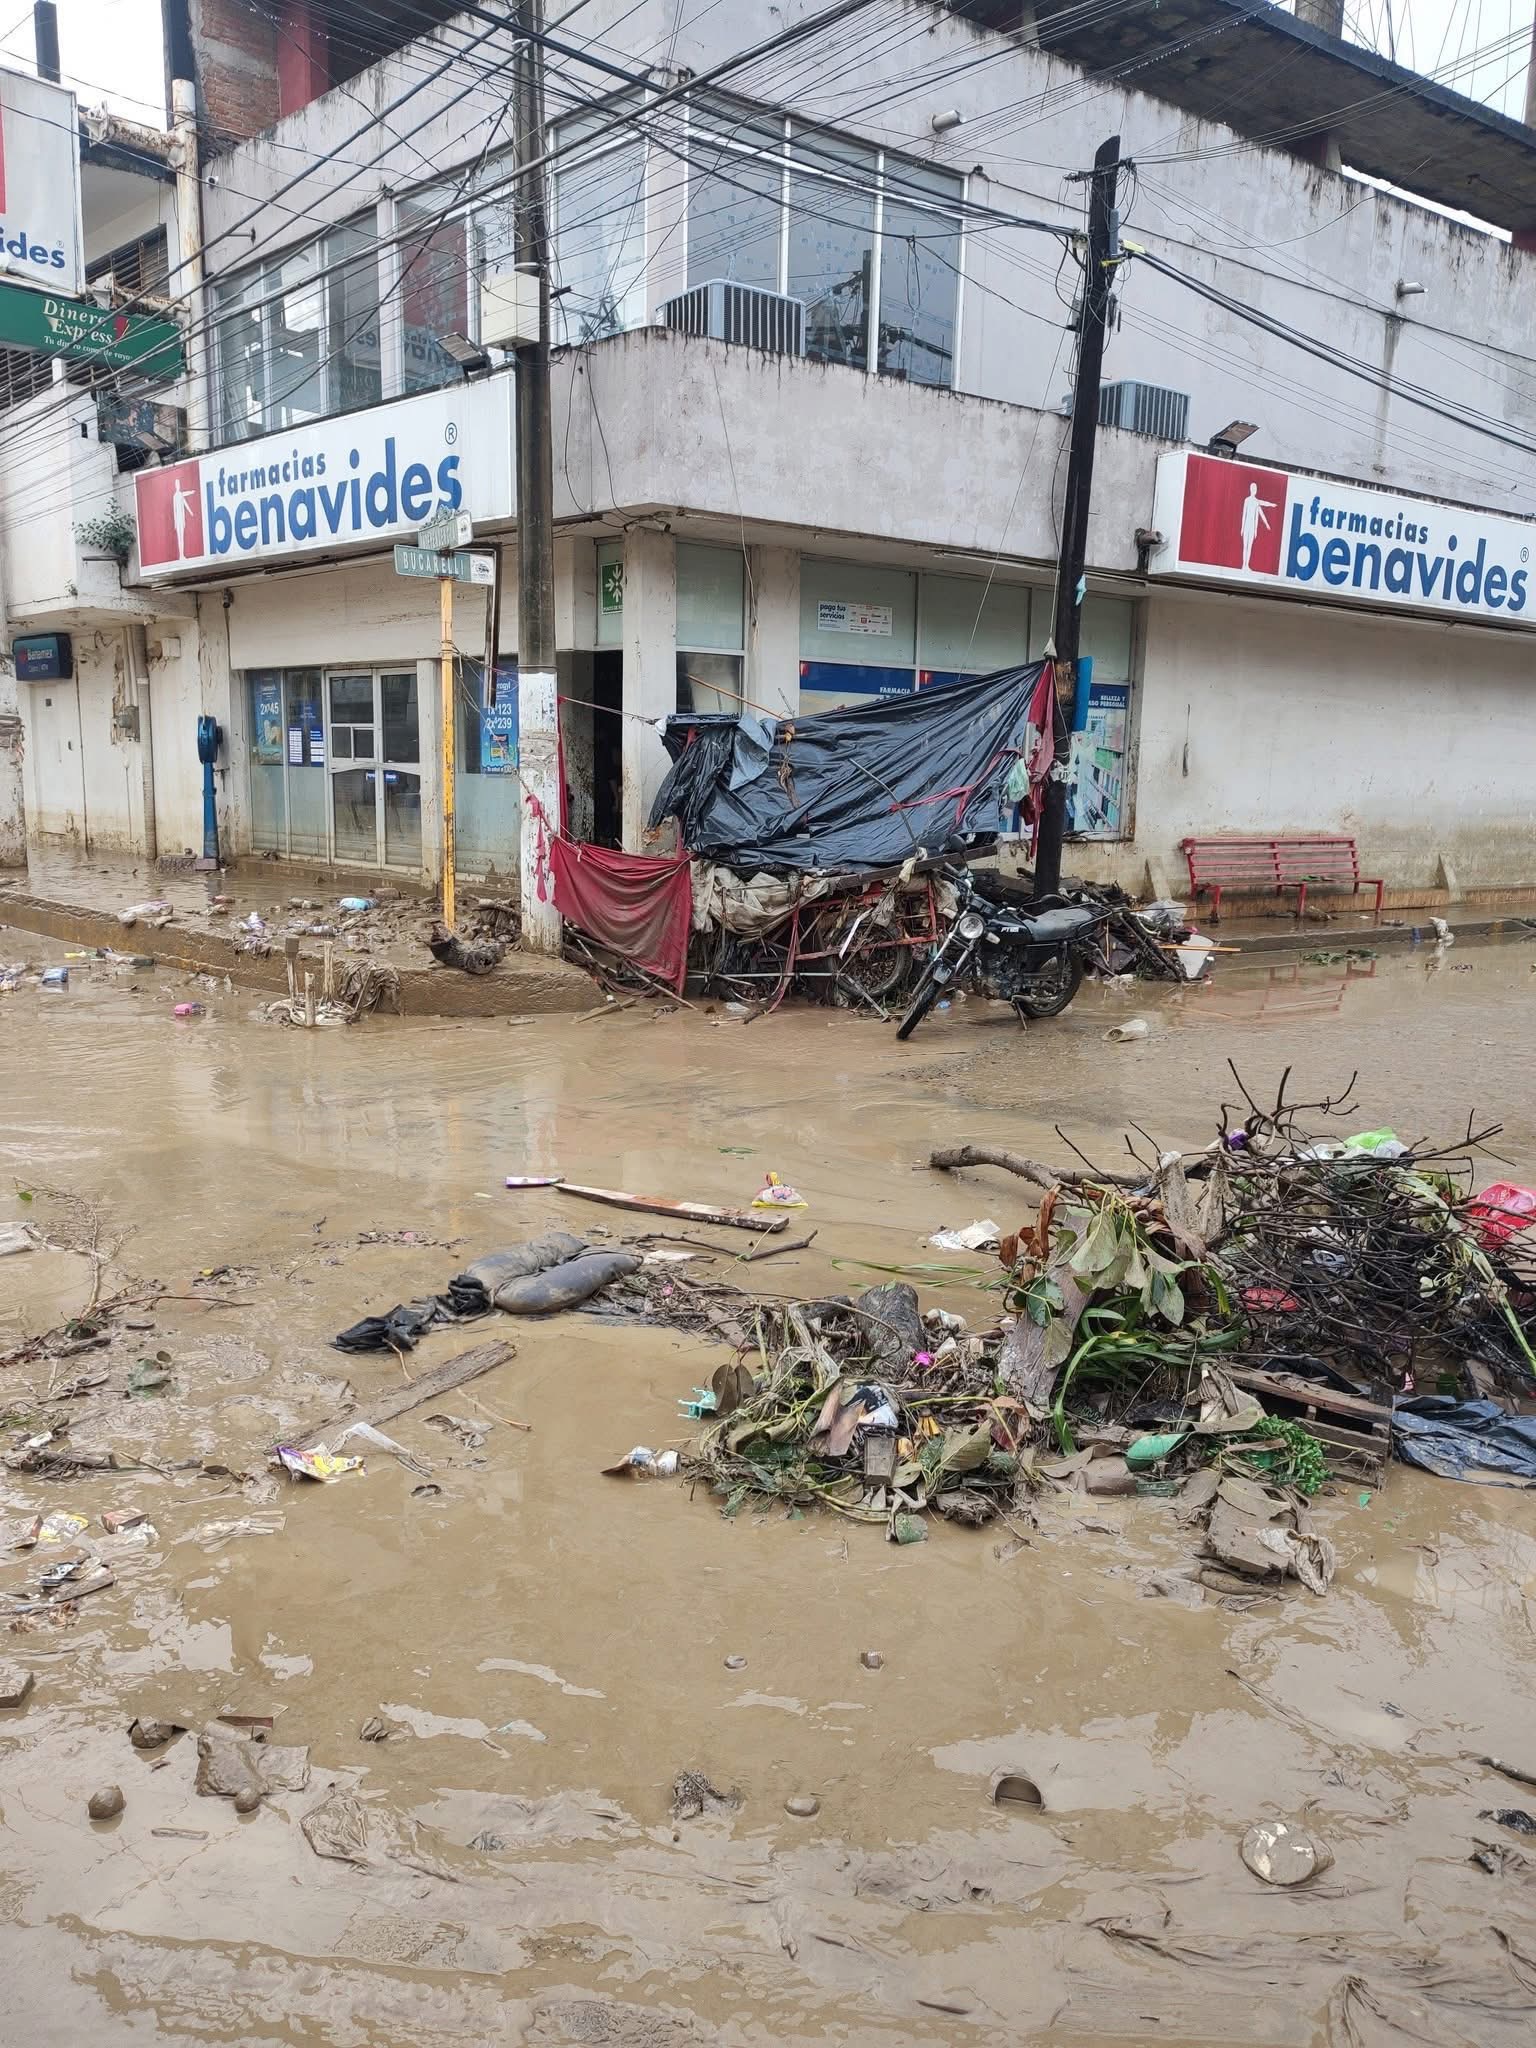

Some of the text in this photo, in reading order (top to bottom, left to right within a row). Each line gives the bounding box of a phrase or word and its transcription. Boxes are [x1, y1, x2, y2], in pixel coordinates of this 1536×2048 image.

[0, 226, 66, 269] ides
[206, 437, 463, 555] benavides
[218, 449, 326, 498] farmacias
[1310, 496, 1429, 545] farmacias
[402, 551, 464, 576] BUCARELLI
[1286, 502, 1529, 612] benavides
[819, 603, 836, 612] paga
[819, 611, 845, 620] servicios
